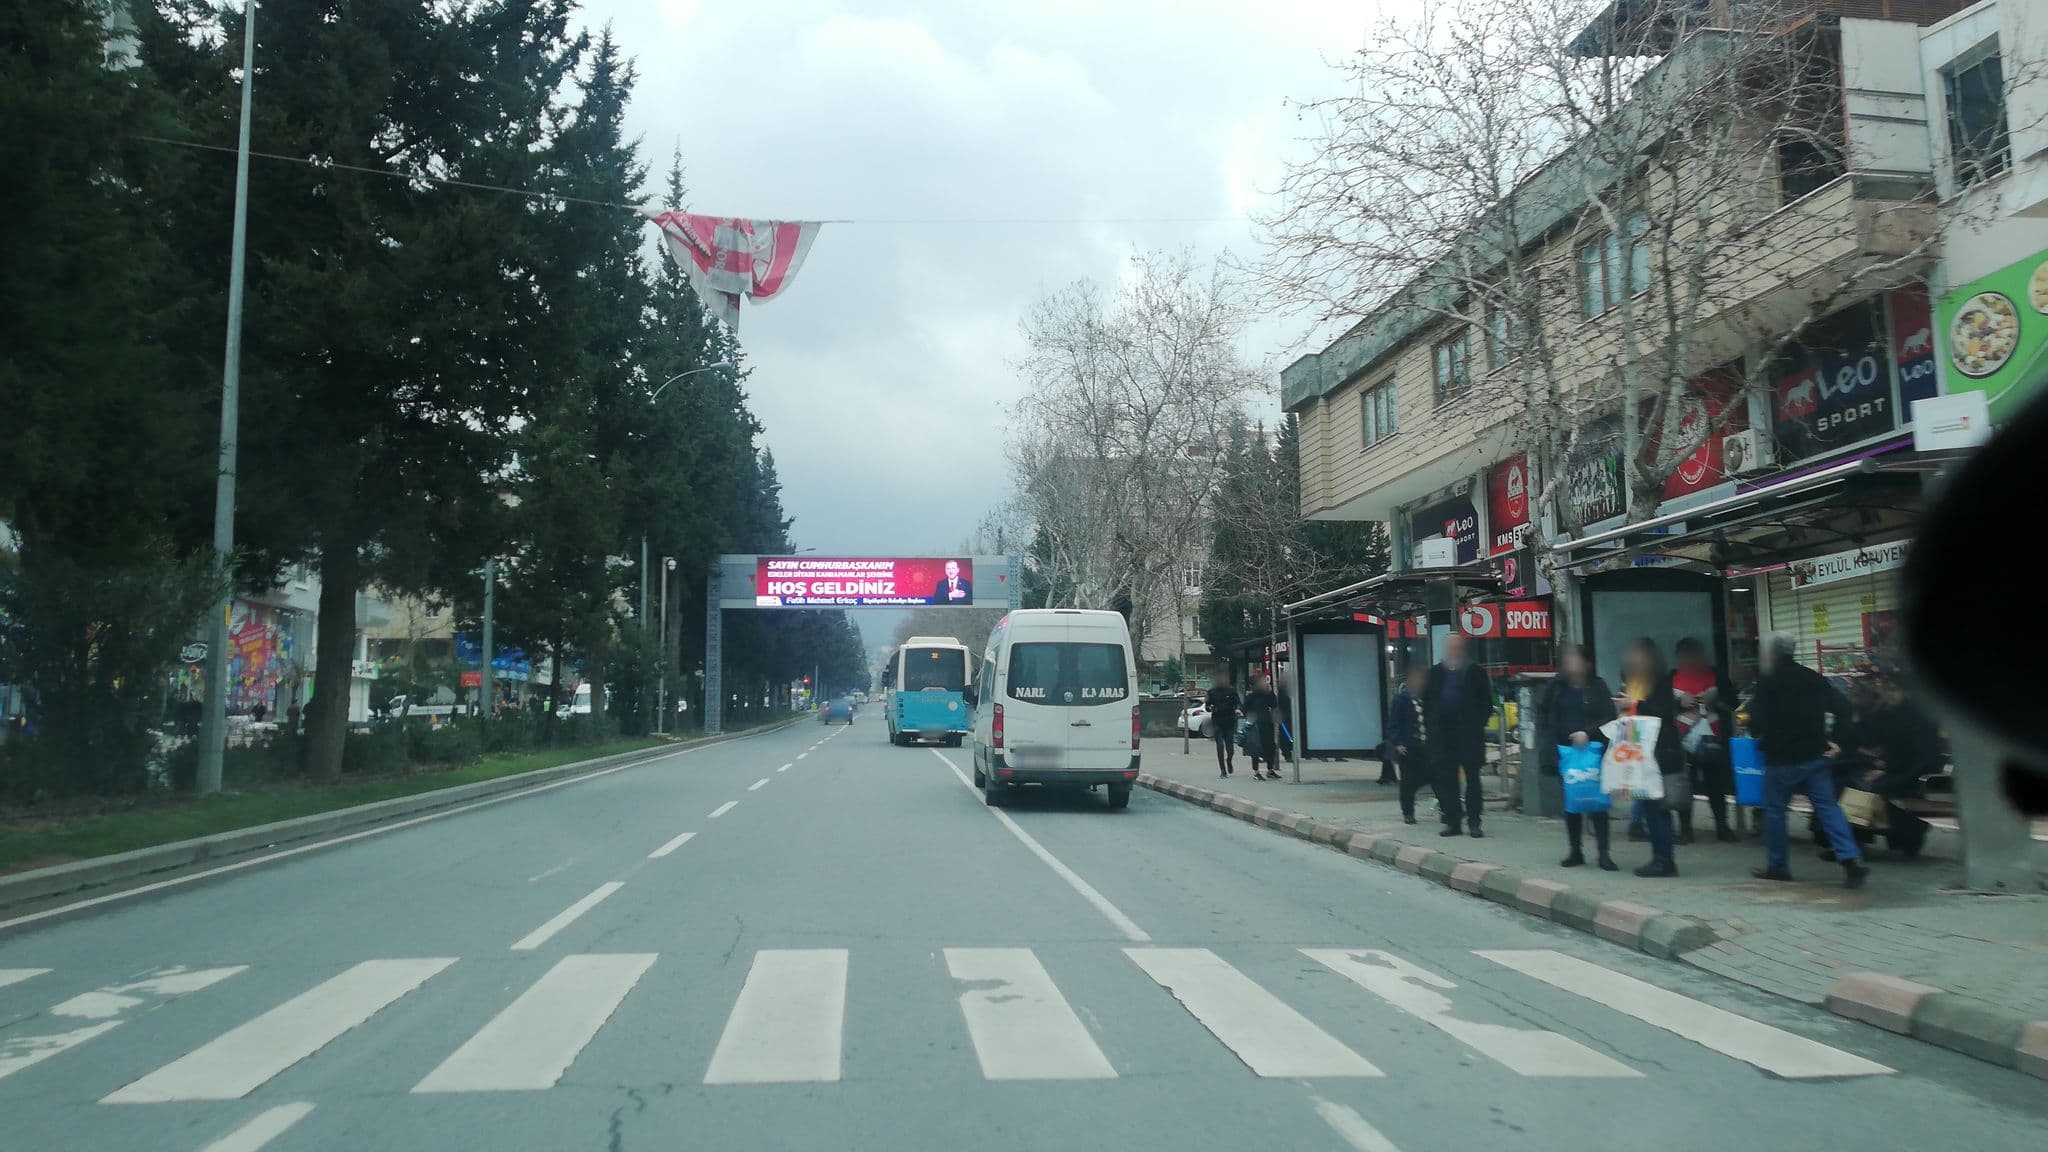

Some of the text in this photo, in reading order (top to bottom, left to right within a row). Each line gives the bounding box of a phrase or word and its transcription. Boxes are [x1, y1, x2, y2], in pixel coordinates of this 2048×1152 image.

[1817, 398, 1886, 432] SPORT
[767, 561, 799, 570] SAYIN
[1819, 557, 1852, 577] EYLÜL
[767, 579, 896, 596] HOŞ GELDİNİZ
[1506, 611, 1548, 630] SPORT
